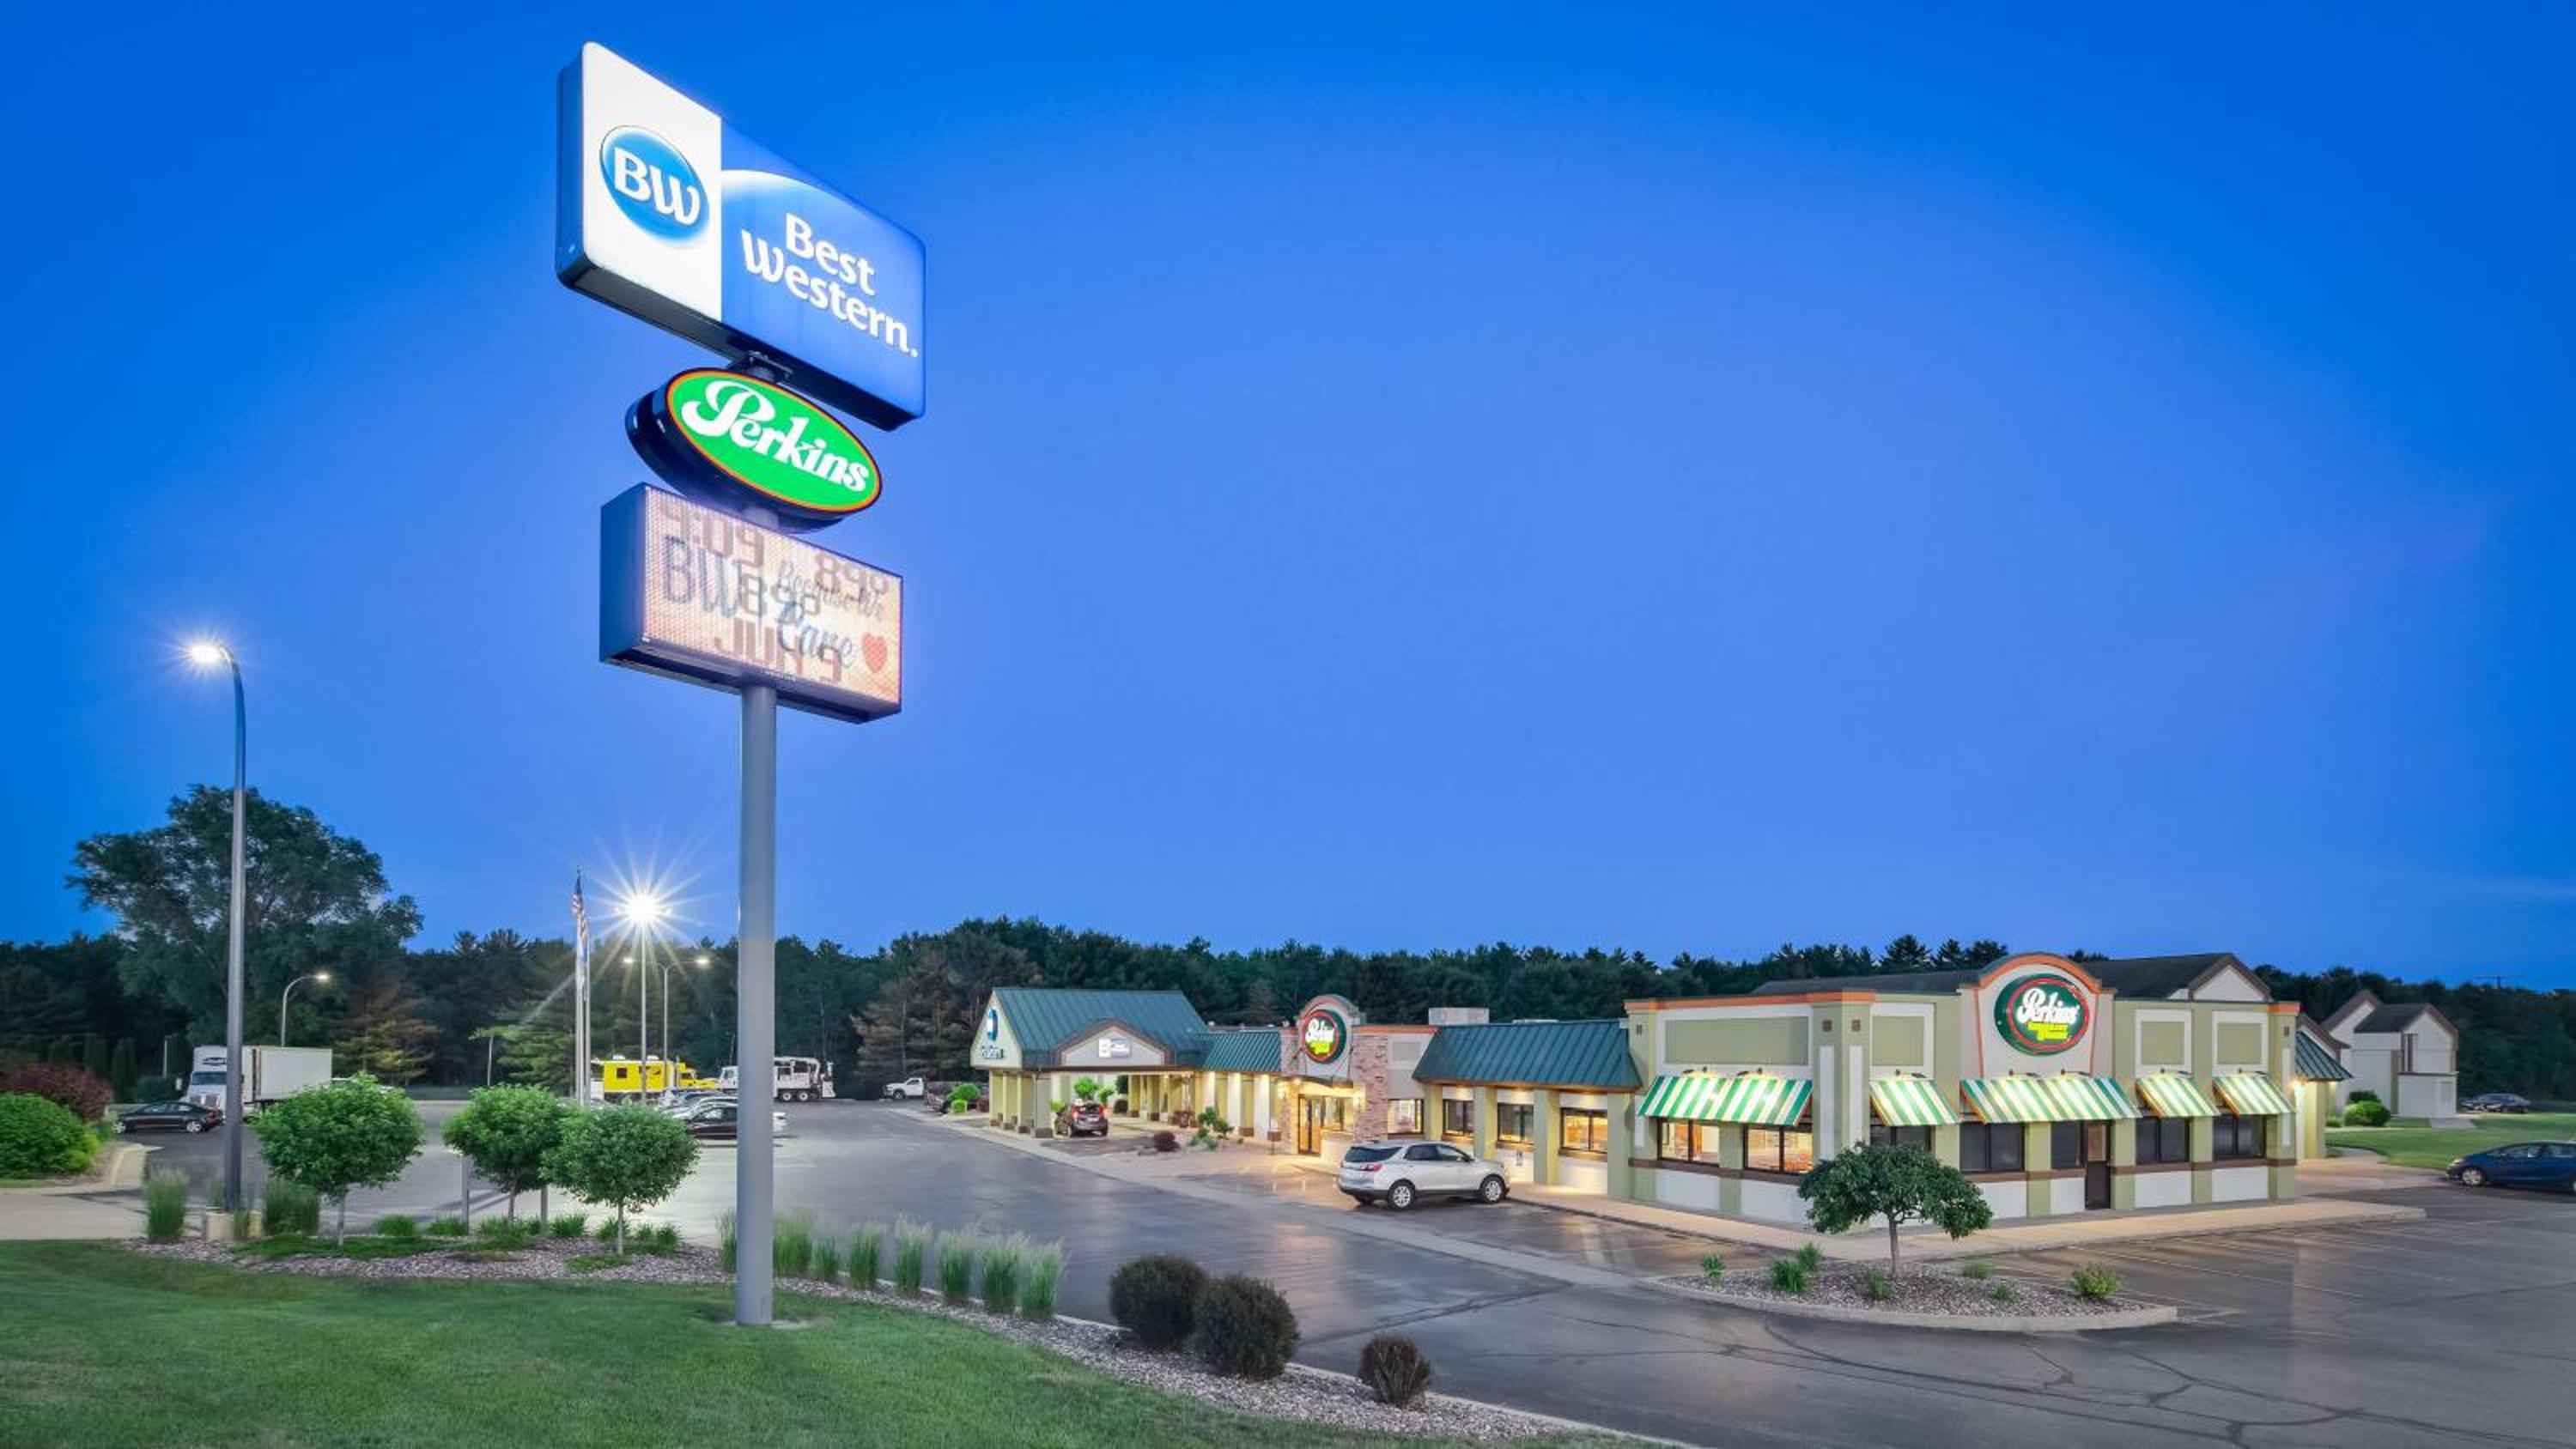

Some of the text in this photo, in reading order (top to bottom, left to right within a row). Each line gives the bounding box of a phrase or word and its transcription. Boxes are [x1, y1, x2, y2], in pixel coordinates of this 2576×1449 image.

[614, 147, 700, 226] BW
[785, 213, 877, 296] Best
[681, 380, 869, 492] Perkins
